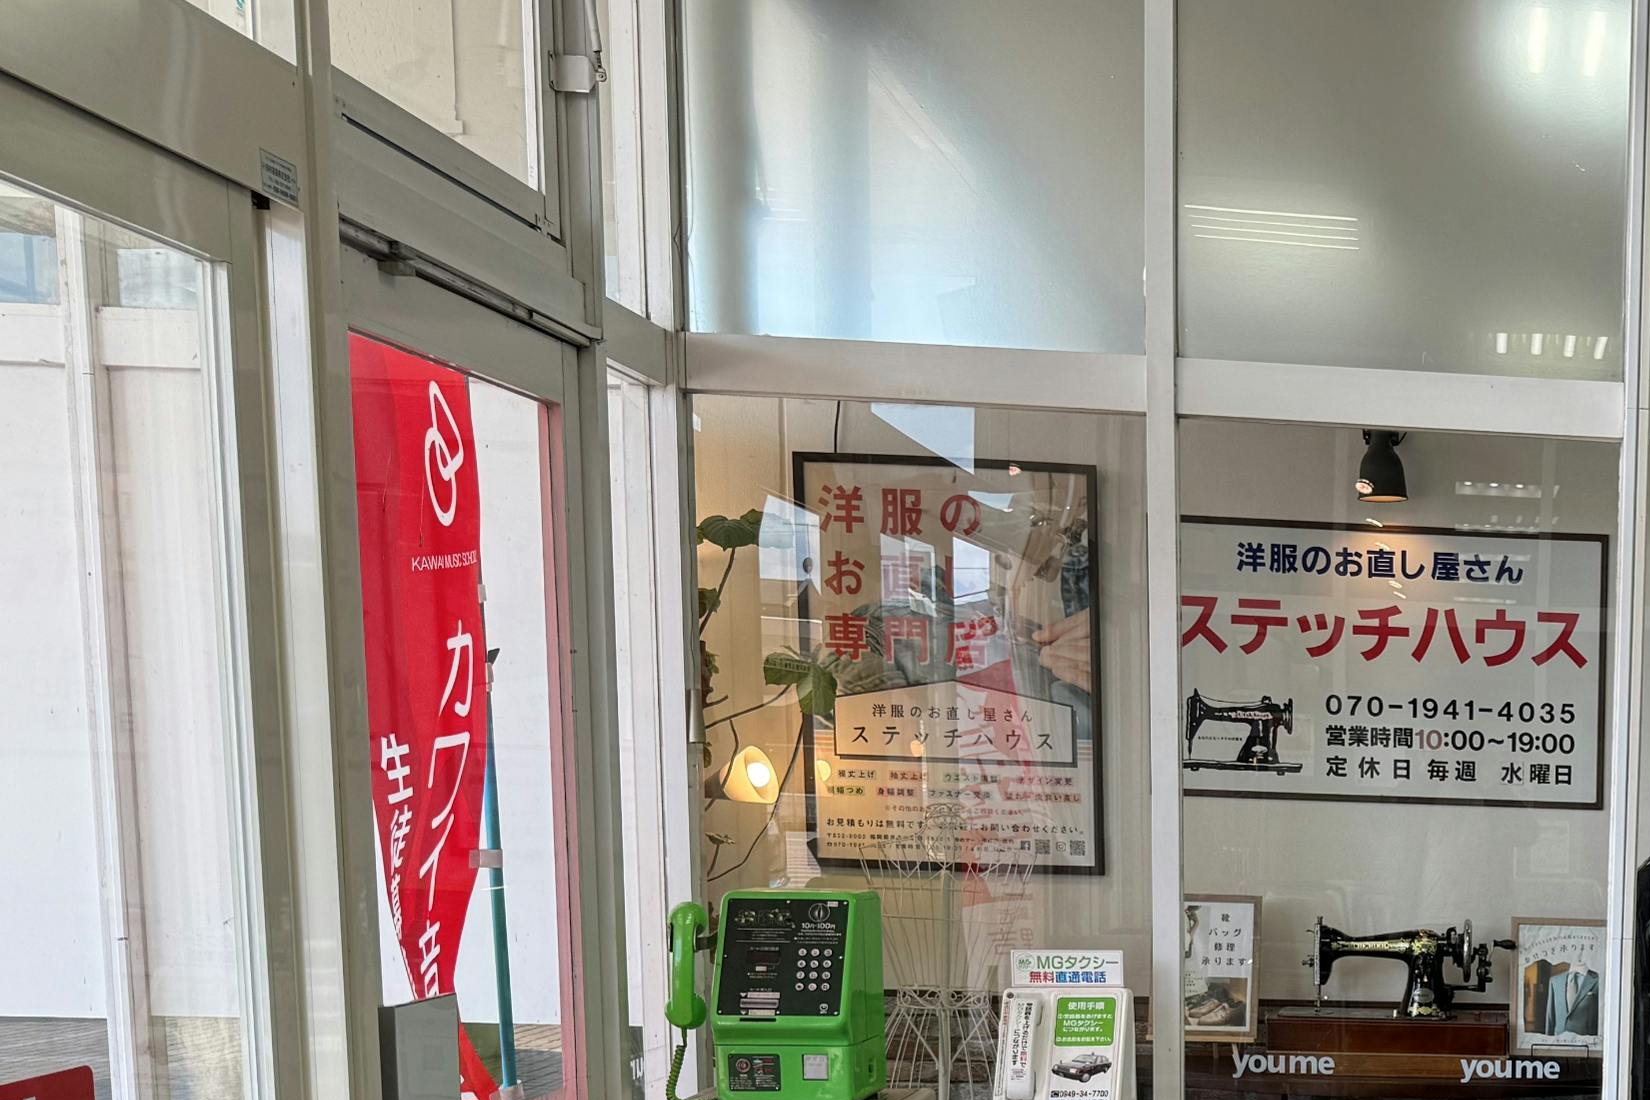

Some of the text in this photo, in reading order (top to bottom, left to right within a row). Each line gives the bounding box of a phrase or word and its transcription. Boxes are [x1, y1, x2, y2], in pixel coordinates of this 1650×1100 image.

[820, 484, 983, 536] 洋服の
[1236, 542, 1523, 585] 洋服のお直し屋さん
[1182, 595, 1588, 669] ステッチハウス
[873, 703, 1033, 723] 洋服のお直し屋さん
[1325, 694, 1576, 724] 070-1941-4035
[852, 726, 1053, 751] ステッチハウス
[1326, 756, 1573, 786] 定休日 毎週 水曜日
[1208, 928, 1241, 937] バッグ
[1214, 942, 1235, 951] 修理
[1037, 955, 1119, 970] MGタクシー
[1201, 956, 1246, 966] 承ります
[1029, 971, 1106, 983] 無料直通電話
[1068, 1001, 1104, 1010] 使用手順
[1233, 1052, 1335, 1079] youme
[1460, 1056, 1560, 1083] youme
[1059, 1090, 1109, 1098] 0949-34-7700
